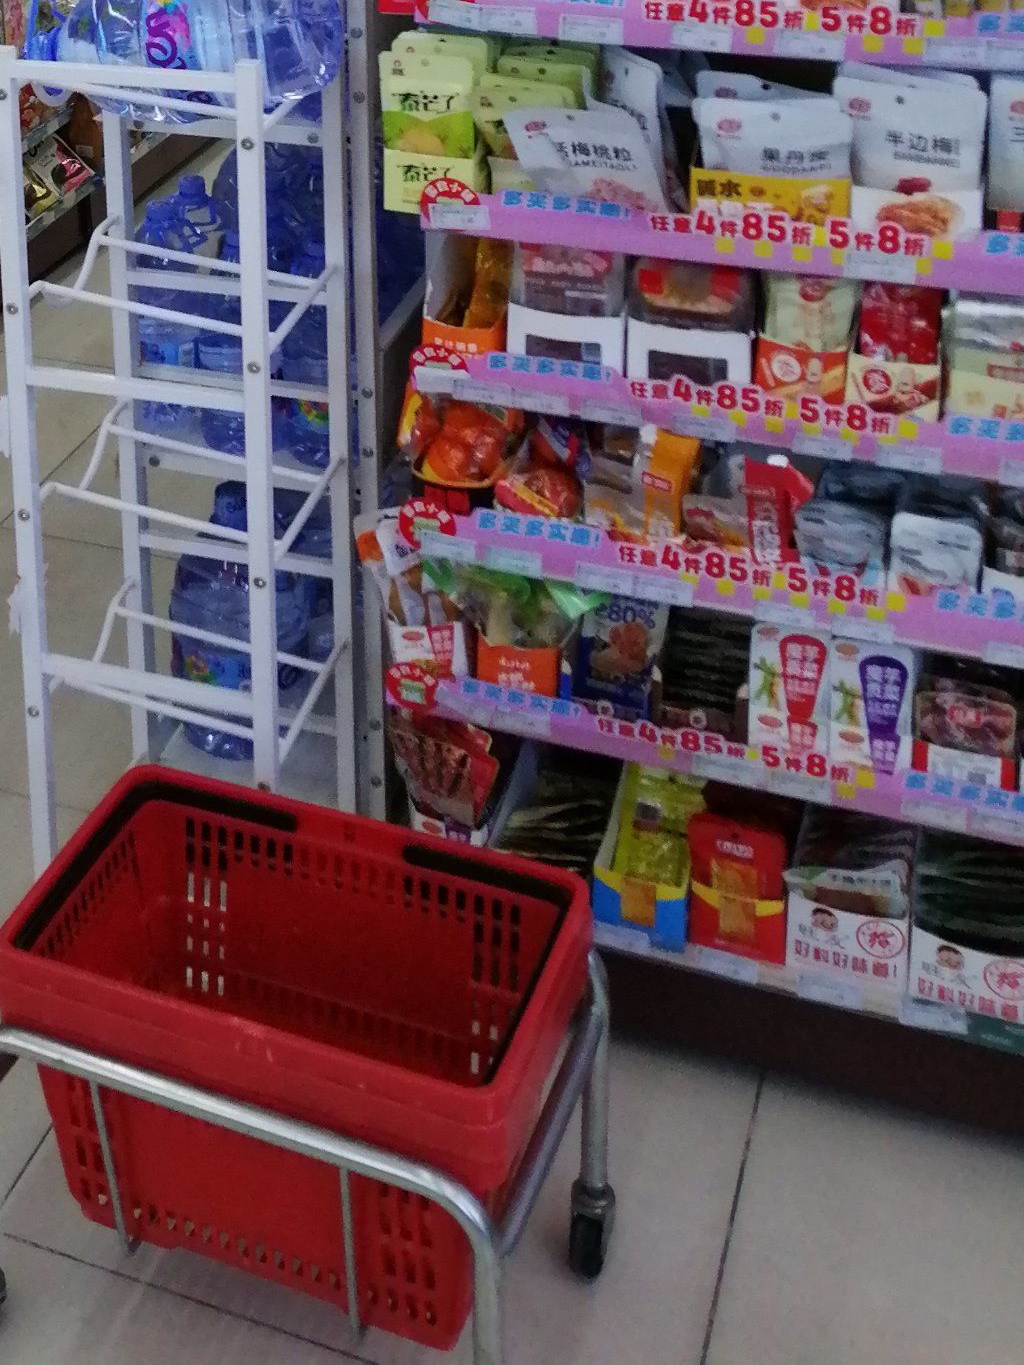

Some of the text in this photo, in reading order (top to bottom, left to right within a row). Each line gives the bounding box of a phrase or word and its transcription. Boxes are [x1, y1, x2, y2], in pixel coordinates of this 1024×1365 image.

[822, 0, 918, 36] 5件8折
[650, 209, 813, 247] 任意4件85折
[828, 220, 926, 258] 5件8折
[630, 378, 784, 417] 任意4件85折
[799, 397, 891, 435] 5件8折
[618, 543, 773, 589] 任意4件85折
[787, 567, 881, 608] 5件8折
[762, 745, 850, 783] 5件8折
